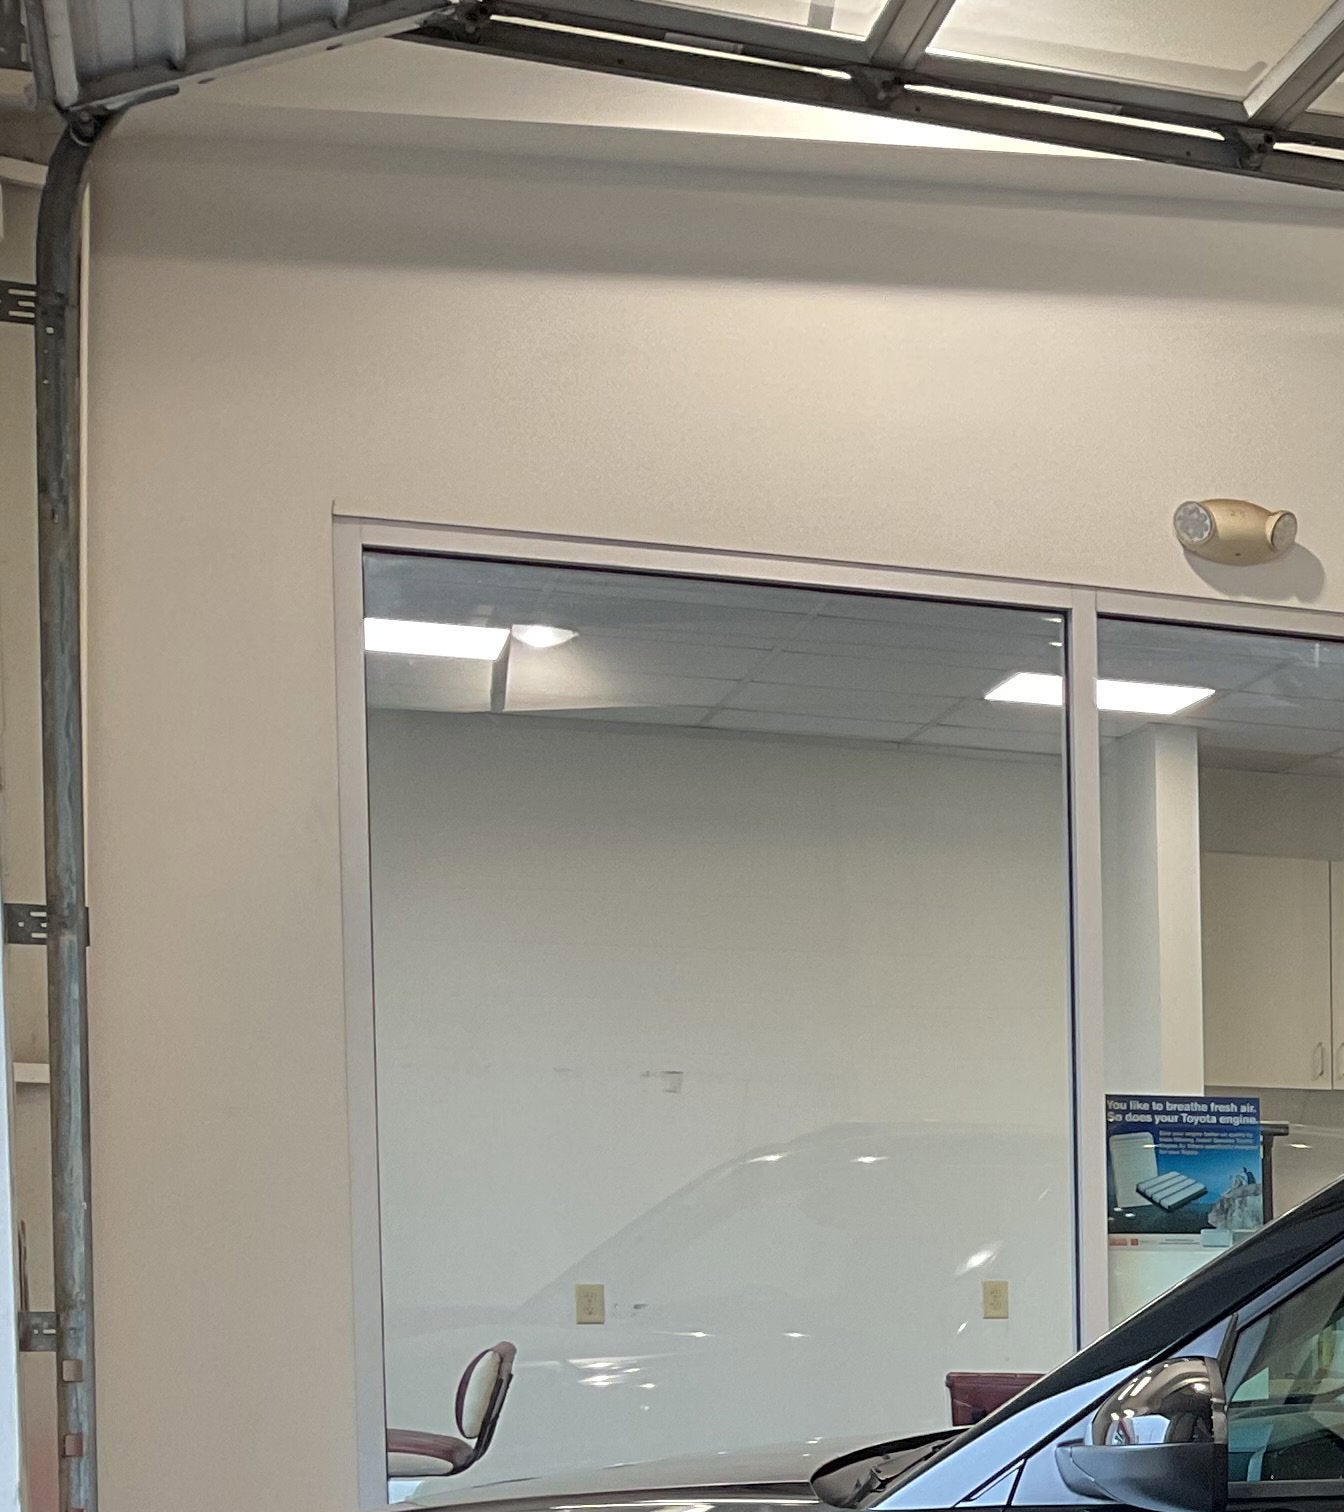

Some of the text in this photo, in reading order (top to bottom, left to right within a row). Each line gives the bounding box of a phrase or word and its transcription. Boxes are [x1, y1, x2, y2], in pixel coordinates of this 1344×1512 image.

[1107, 1100, 1257, 1113] You like to breathe fresh air.
[1107, 1112, 1122, 1122] So
[1125, 1112, 1152, 1122] does
[1154, 1113, 1179, 1125] your
[1181, 1113, 1217, 1126] Toyota
